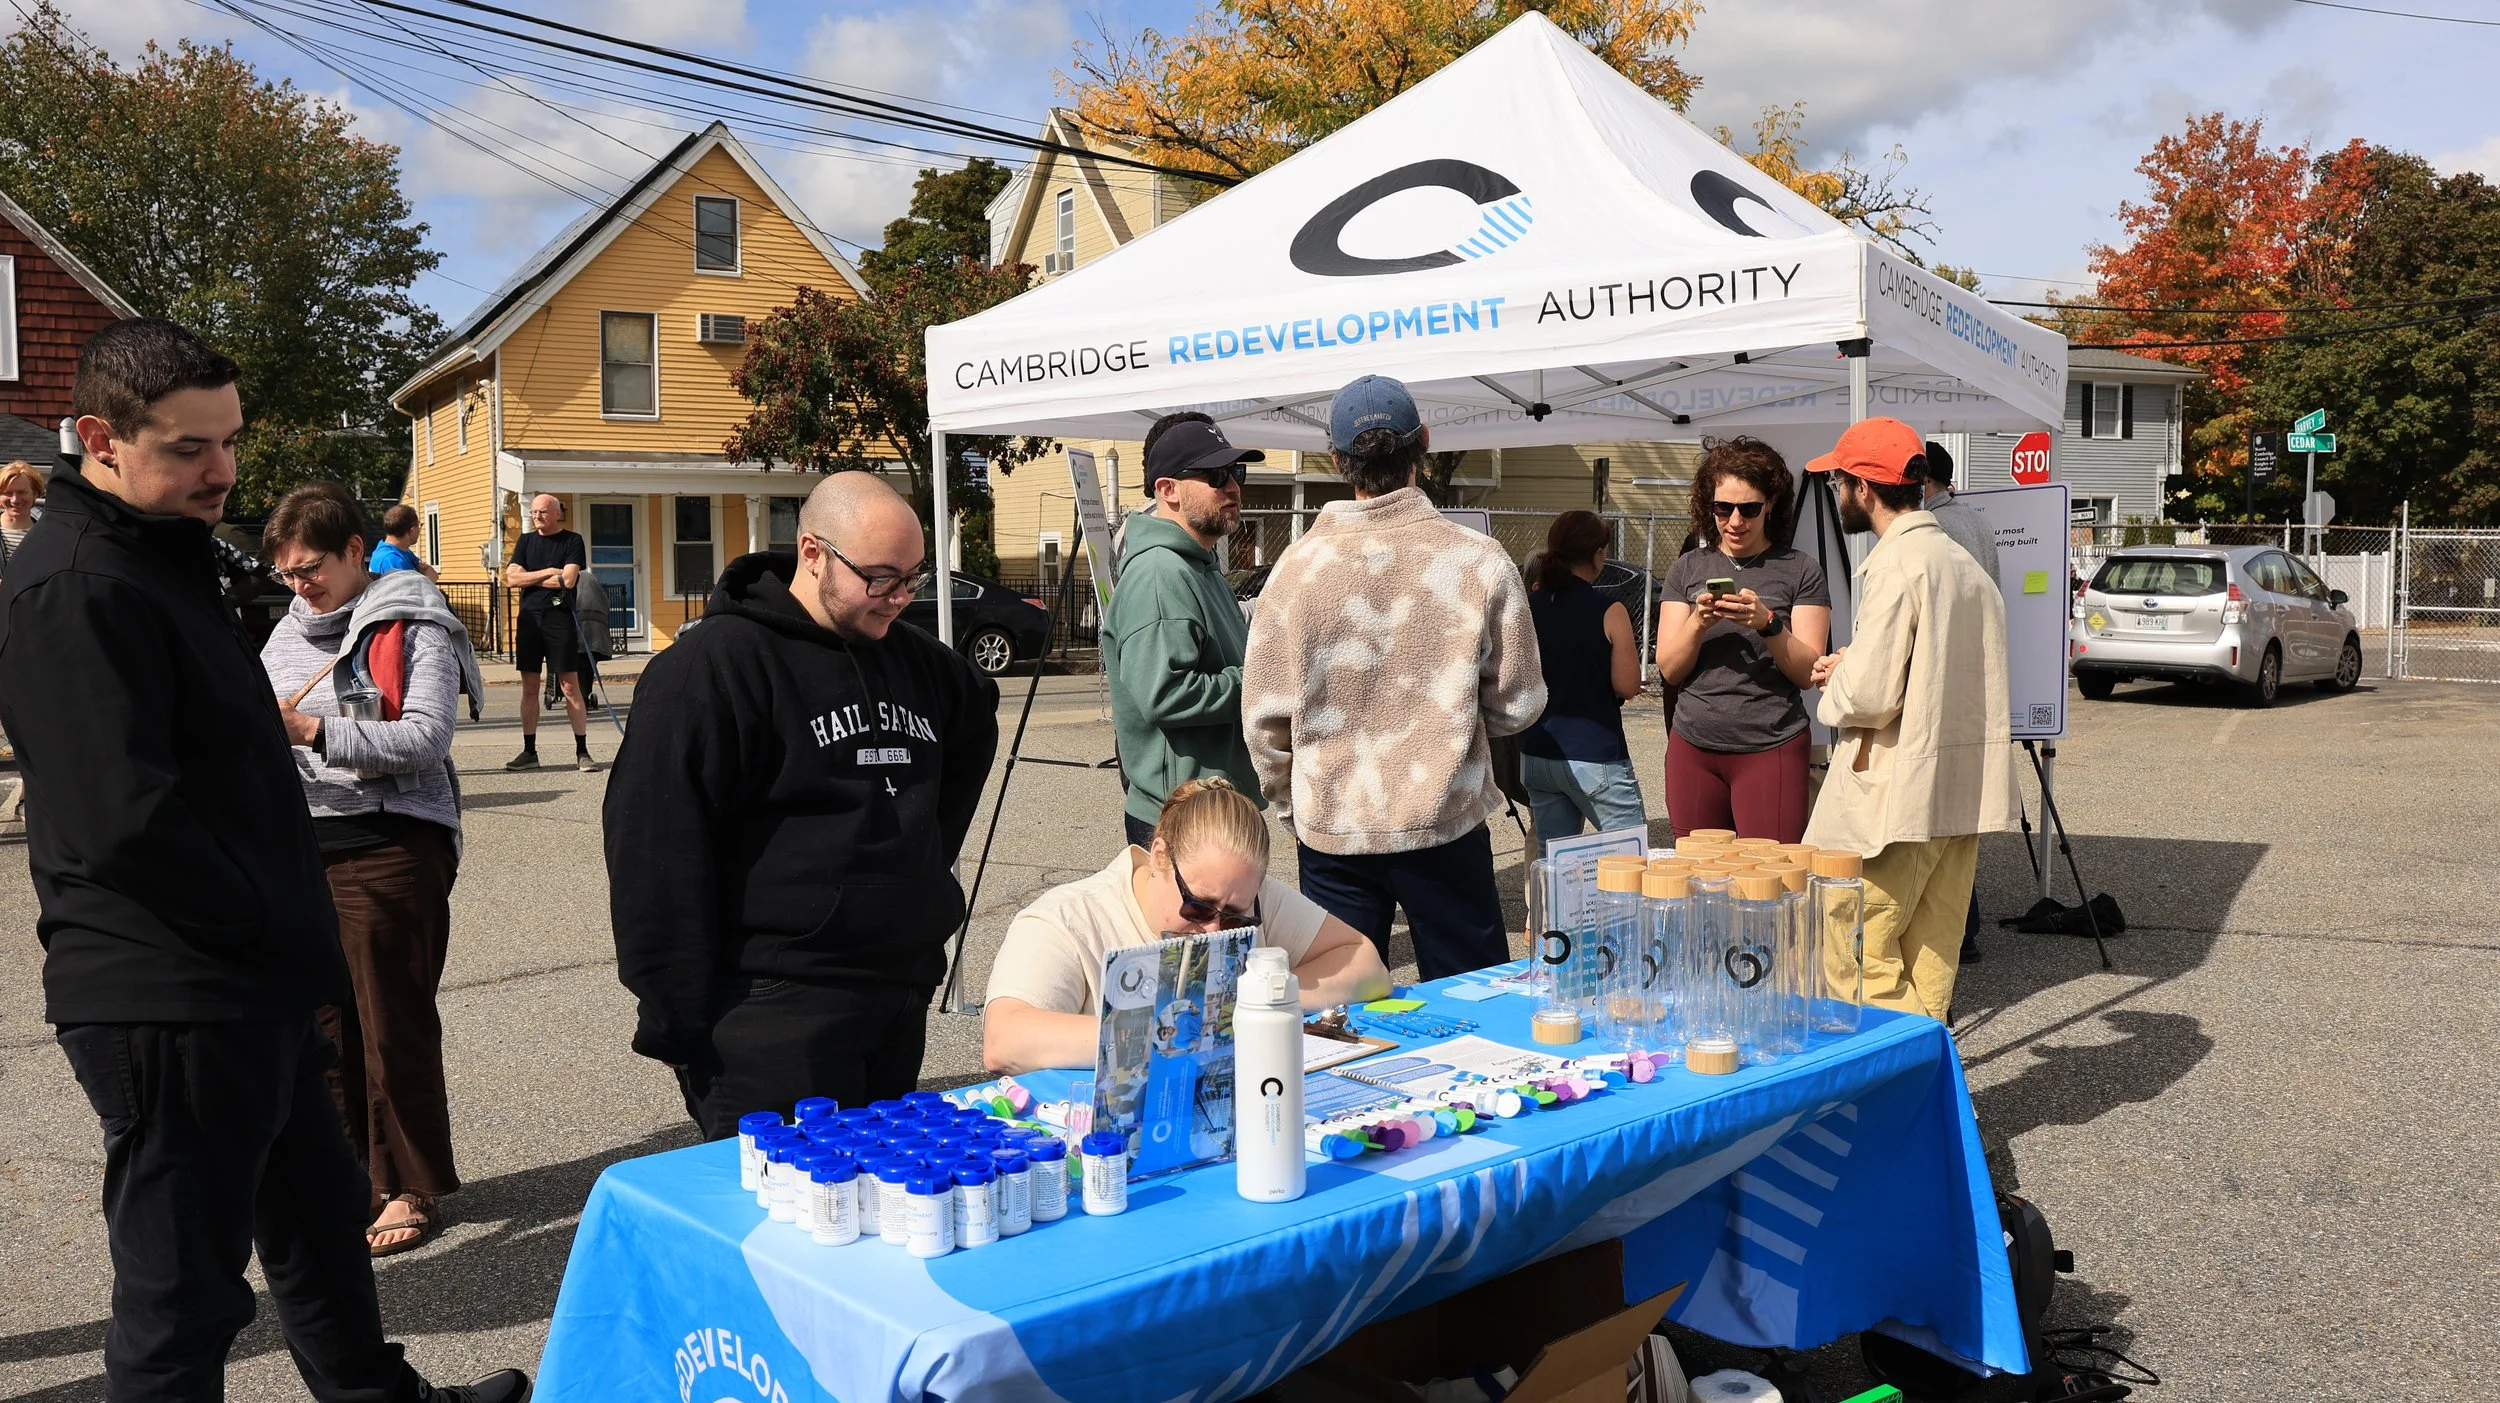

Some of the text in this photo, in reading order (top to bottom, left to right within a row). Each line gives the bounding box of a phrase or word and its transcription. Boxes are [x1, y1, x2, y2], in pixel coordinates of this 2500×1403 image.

[955, 263, 1802, 390] CAMBRIDGE REDEVELOPMENT AUTHORITY
[1878, 260, 2061, 394] CAMBRIDGE REDEVELOPMENT AUTHORITY
[2296, 416, 2315, 433] HARVEY
[2291, 436, 2334, 449] CEDAR ST
[2002, 527, 2025, 535] most
[1996, 538, 2039, 548] eing built
[810, 701, 938, 748] HAIL SATAN
[887, 749, 904, 761] 666
